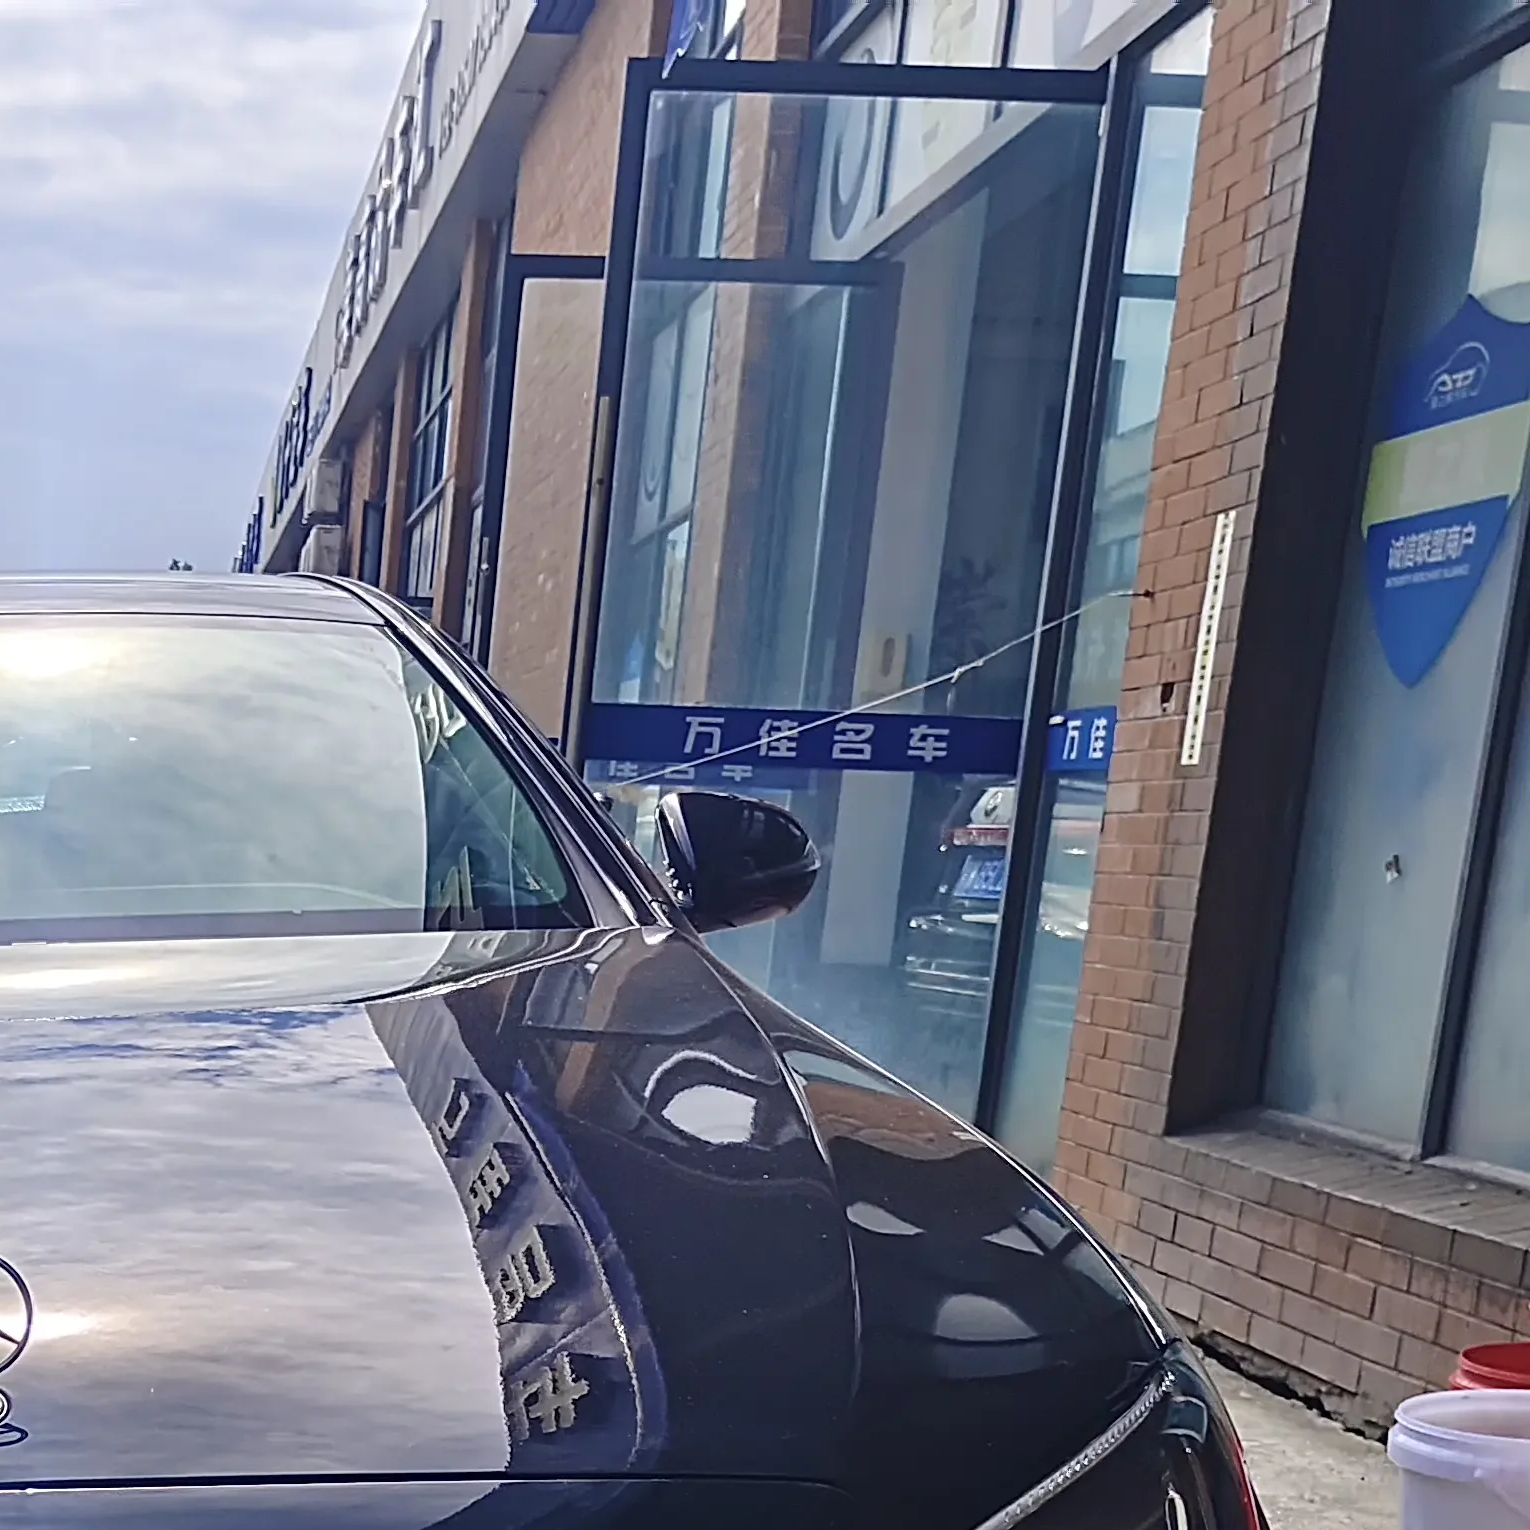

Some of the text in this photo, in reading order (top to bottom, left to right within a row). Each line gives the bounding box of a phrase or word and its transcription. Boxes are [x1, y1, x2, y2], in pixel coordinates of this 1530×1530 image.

[683, 716, 951, 763] 万佳名车
[1062, 716, 1107, 760] 万佳
